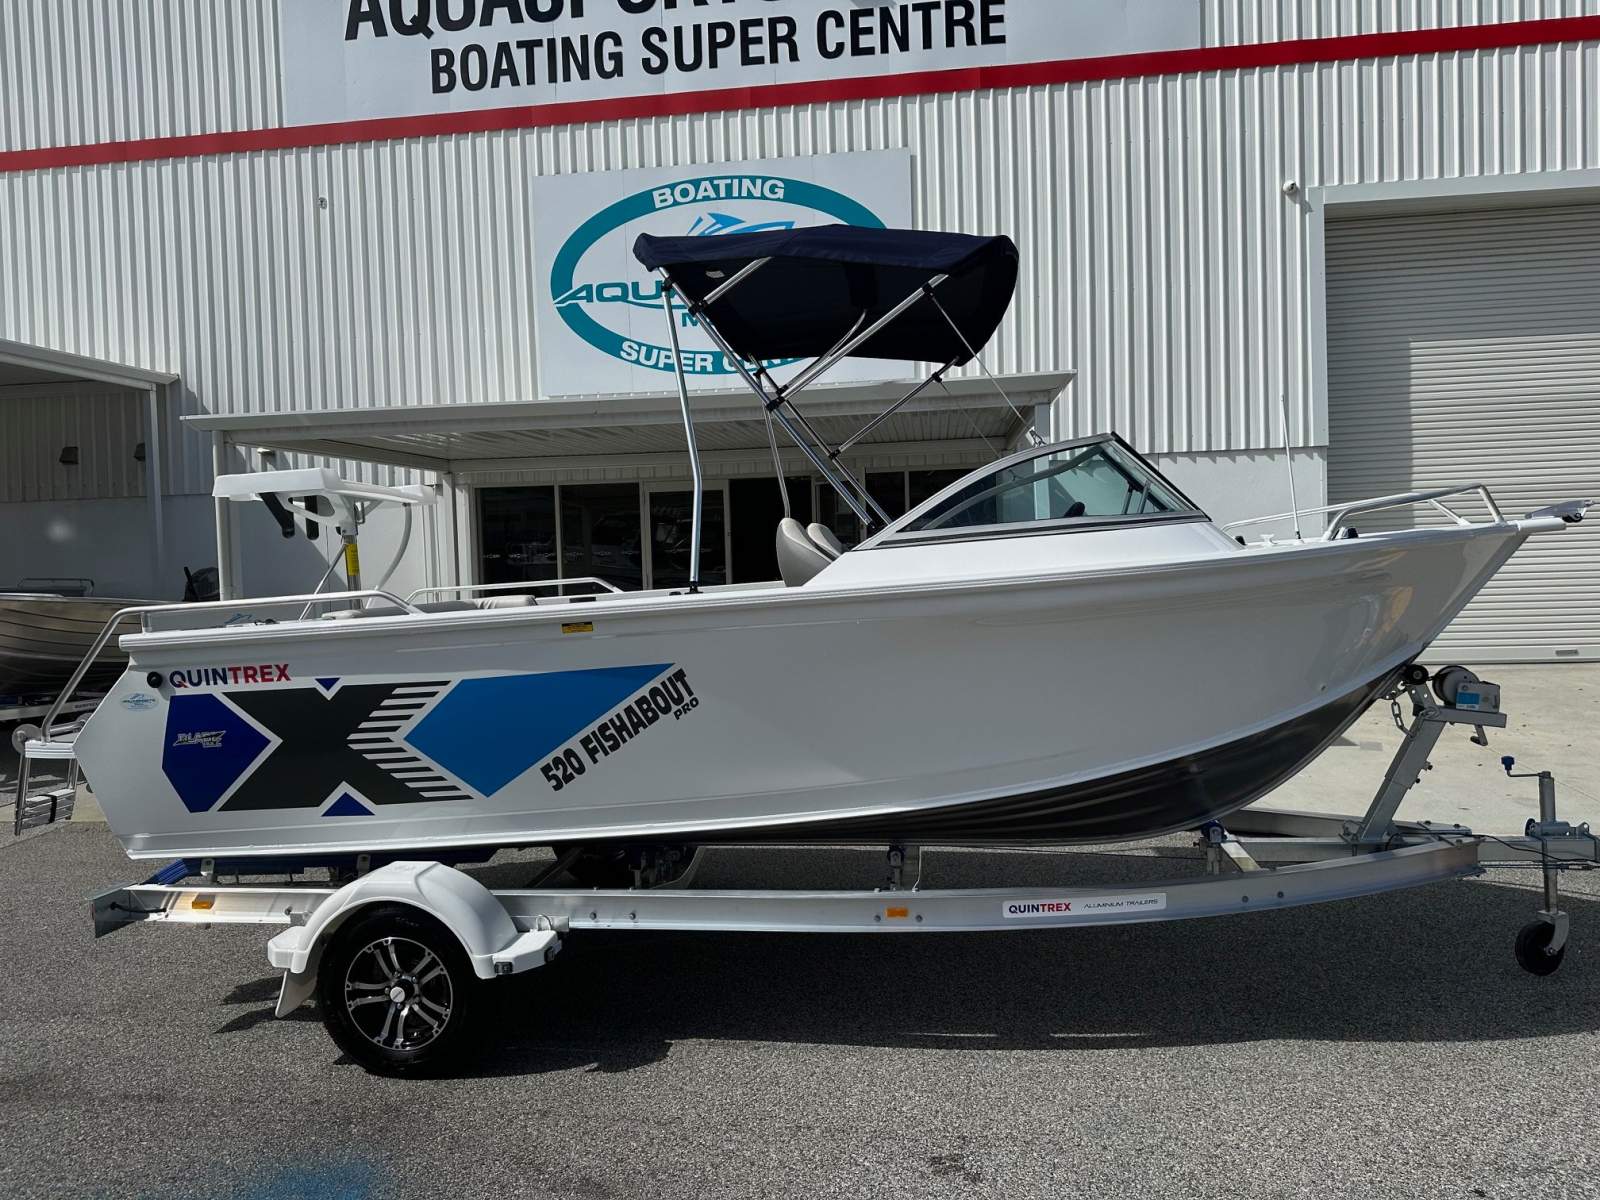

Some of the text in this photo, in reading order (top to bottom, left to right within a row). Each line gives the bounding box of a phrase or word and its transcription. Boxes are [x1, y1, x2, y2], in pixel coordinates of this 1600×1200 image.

[431, 31, 623, 93] BOATING
[642, 15, 799, 75] SUPER
[816, 0, 1006, 60] CENTRE
[652, 178, 785, 209] BOATING
[169, 664, 292, 688] QUINTREX
[673, 697, 699, 720] PRO
[540, 668, 694, 791] 520 FISHABOUT
[1008, 902, 1072, 914] QUINTREX
